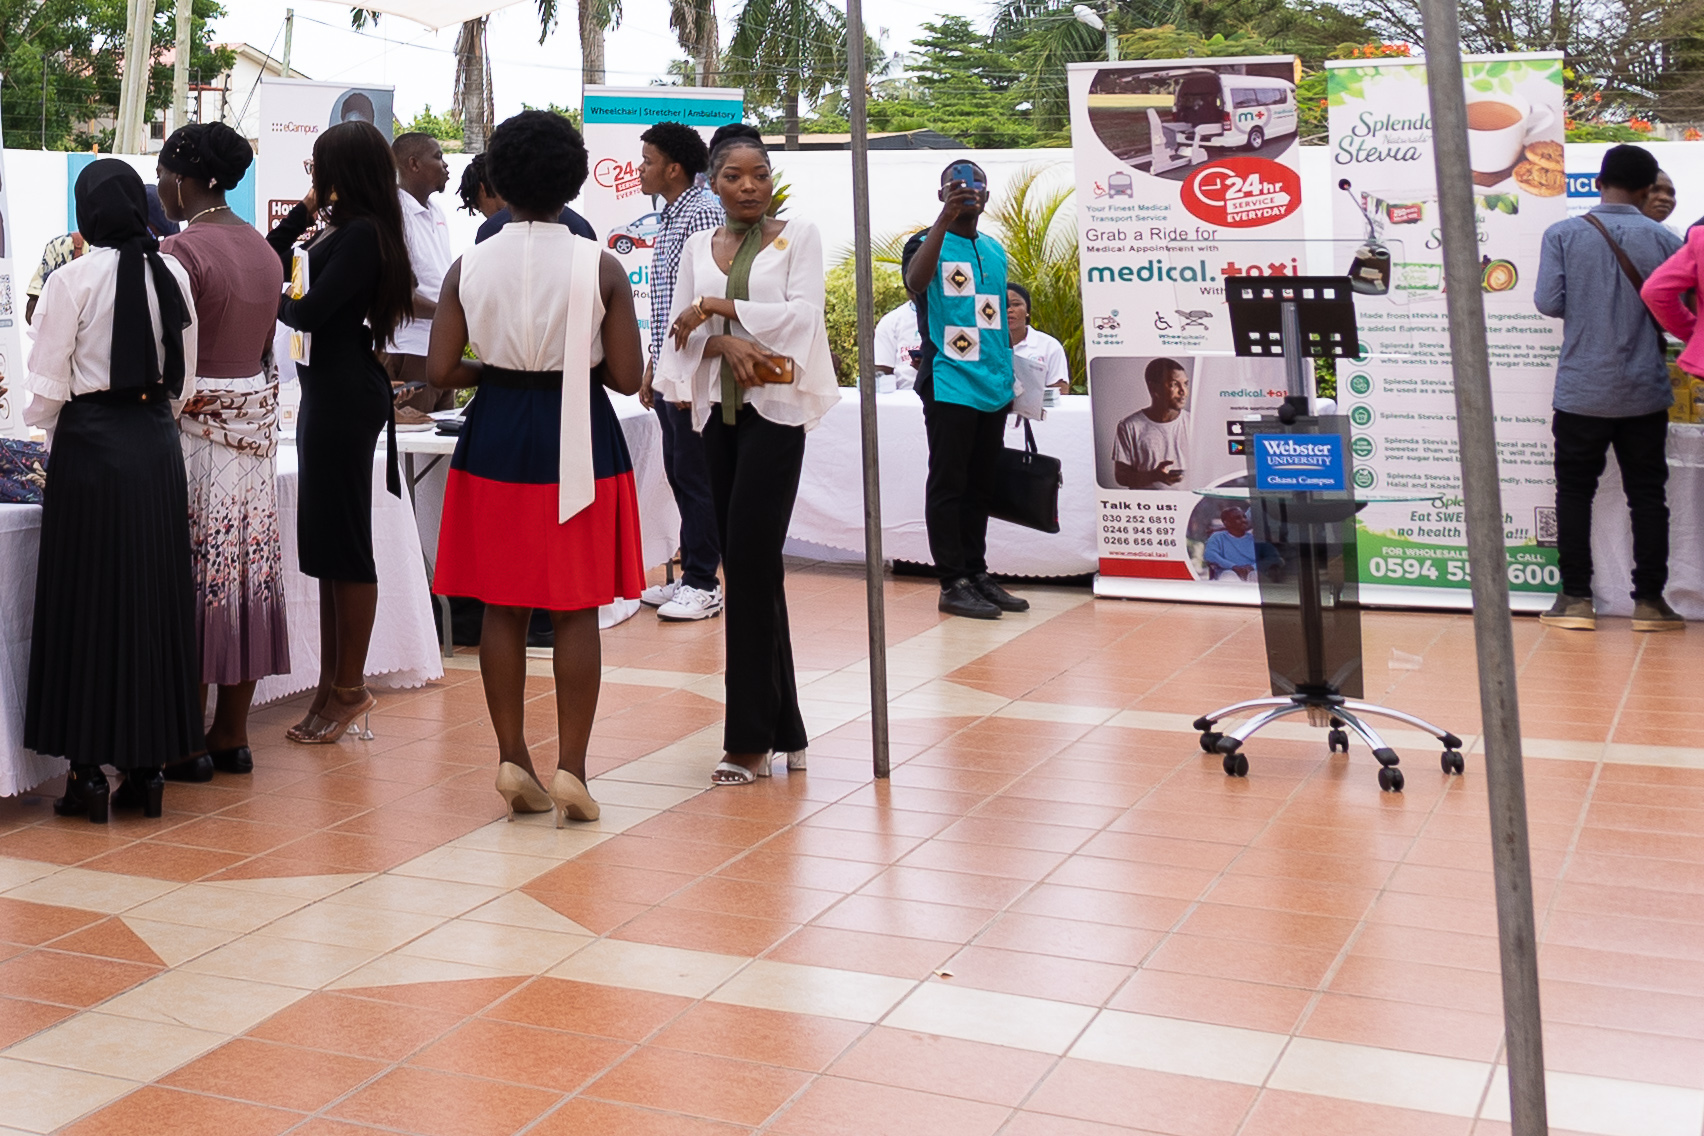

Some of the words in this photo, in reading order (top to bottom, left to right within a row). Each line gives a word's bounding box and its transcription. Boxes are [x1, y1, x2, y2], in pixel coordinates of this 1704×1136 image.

[590, 107, 637, 115] Wheelchair
[643, 107, 681, 117] Stretcher
[687, 109, 736, 120] Ambulatory
[283, 121, 319, 136] eCampus
[1335, 135, 1422, 165] Stevia
[1233, 196, 1275, 209] SERVICE
[1091, 215, 1133, 223] Transport
[1135, 214, 1168, 222] Service
[1227, 206, 1287, 223] EVERYDAY
[1086, 227, 1127, 242] Grab
[1134, 231, 1143, 241] a
[1150, 227, 1188, 241] Ride
[1196, 227, 1218, 241] for
[1129, 245, 1194, 253] Appointment
[1263, 439, 1332, 455] Webster
[1267, 456, 1332, 465] UNIVERSITY
[1267, 475, 1297, 484] Ghana
[1299, 476, 1335, 486] Campus
[1100, 500, 1132, 510] Talk
[1137, 502, 1151, 511] to
[1410, 511, 1431, 522] Eat
[1103, 525, 1129, 534] 0246
[1398, 528, 1413, 536] no
[1417, 526, 1461, 537] health
[1382, 546, 1403, 556] FOR
[1405, 548, 1468, 559] WHOLESALE
[1369, 557, 1438, 580] 0594
[1507, 563, 1560, 586] 600
